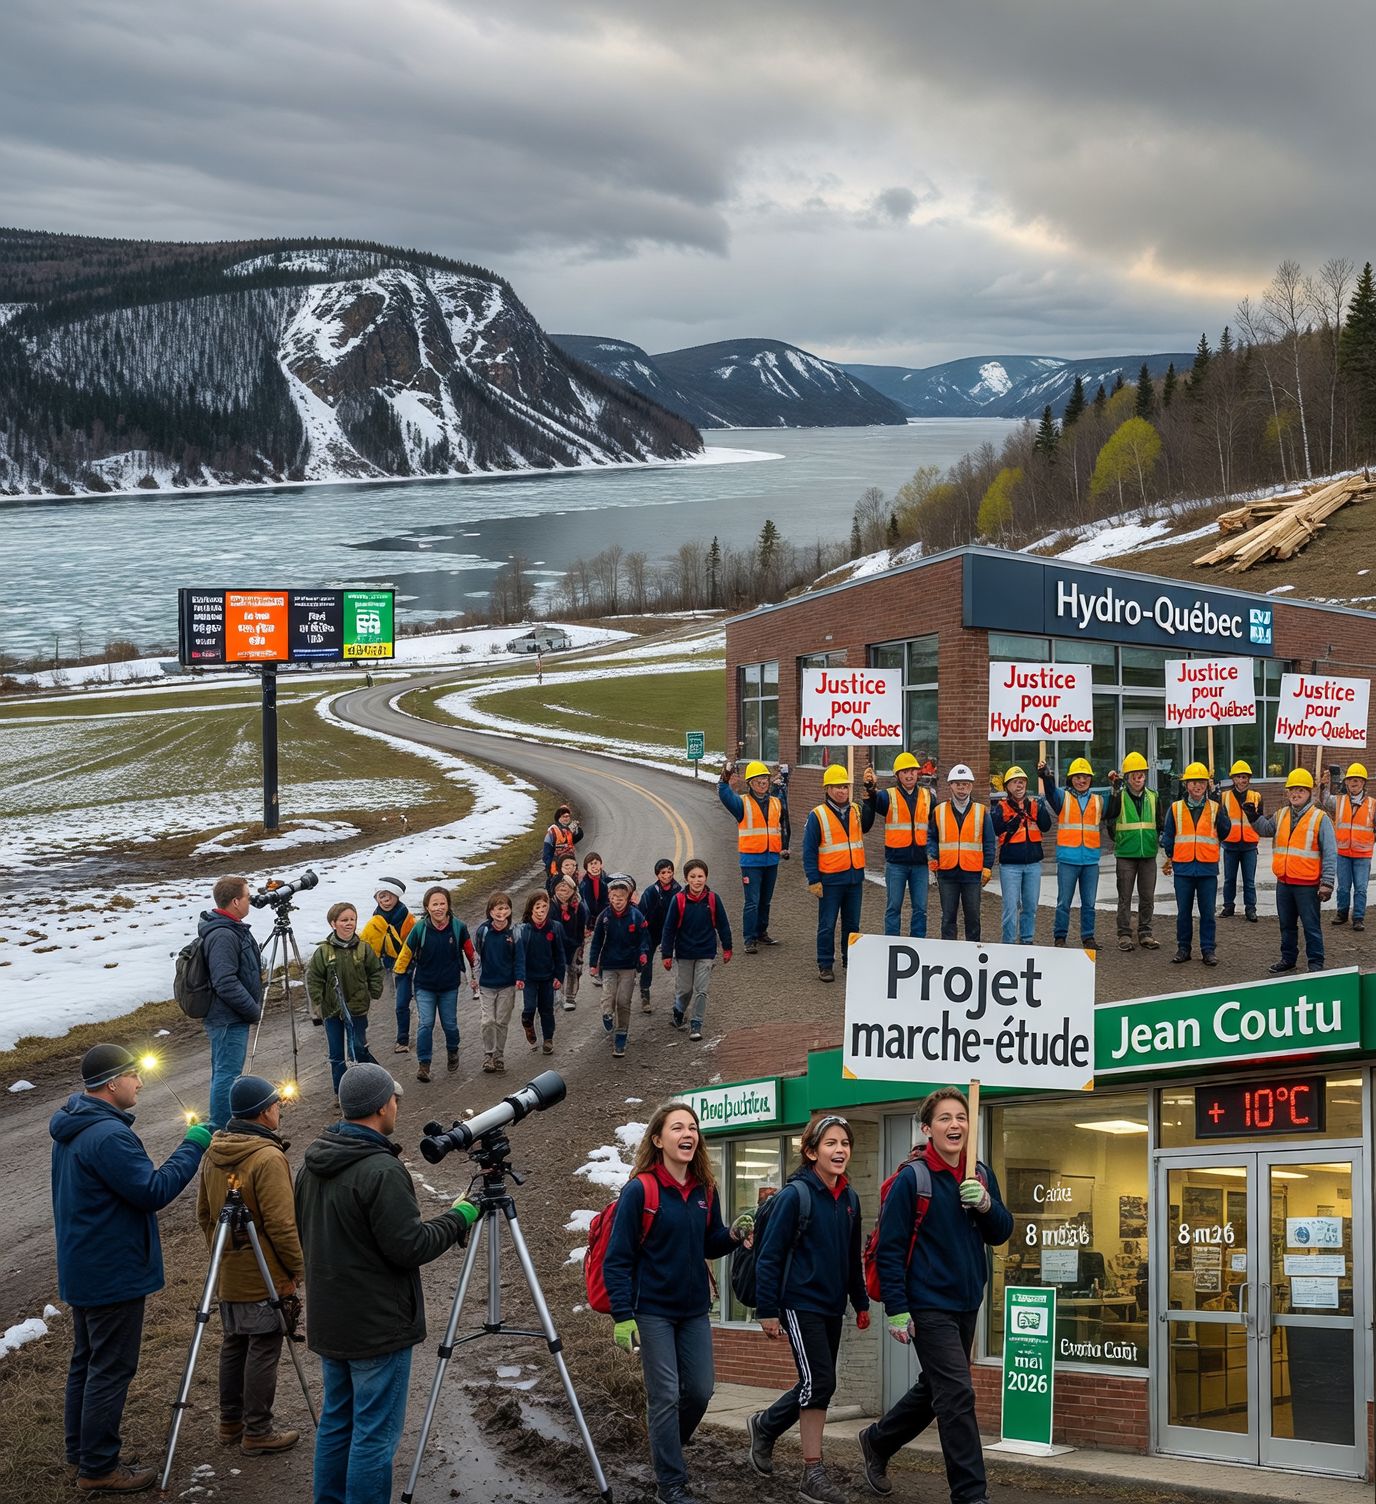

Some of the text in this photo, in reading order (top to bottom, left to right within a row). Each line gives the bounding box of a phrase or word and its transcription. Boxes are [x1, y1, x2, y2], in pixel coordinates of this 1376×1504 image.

[1057, 580, 1243, 639] Hydro-Québec
[815, 672, 886, 694] Justice
[1003, 665, 1076, 689] Justice
[1177, 662, 1238, 682] Justice
[1192, 685, 1225, 702] pour
[1292, 678, 1355, 702] Justice
[831, 700, 871, 718] pour
[1021, 694, 1061, 713] pour
[1167, 700, 1255, 724] Hydro-Québec
[1305, 703, 1341, 719] pour
[801, 717, 901, 742] Hydro-Québec
[991, 712, 1092, 737] Hydro-Québec
[887, 944, 1043, 1020] Projet
[851, 1010, 1090, 1068] marche-étude
[1111, 995, 1342, 1059] Jean Coutu
[1245, 1085, 1310, 1128] 10°C
[1025, 1223, 1037, 1246] 8
[1178, 1223, 1190, 1245] 8
[1007, 1371, 1048, 1394] 2026
